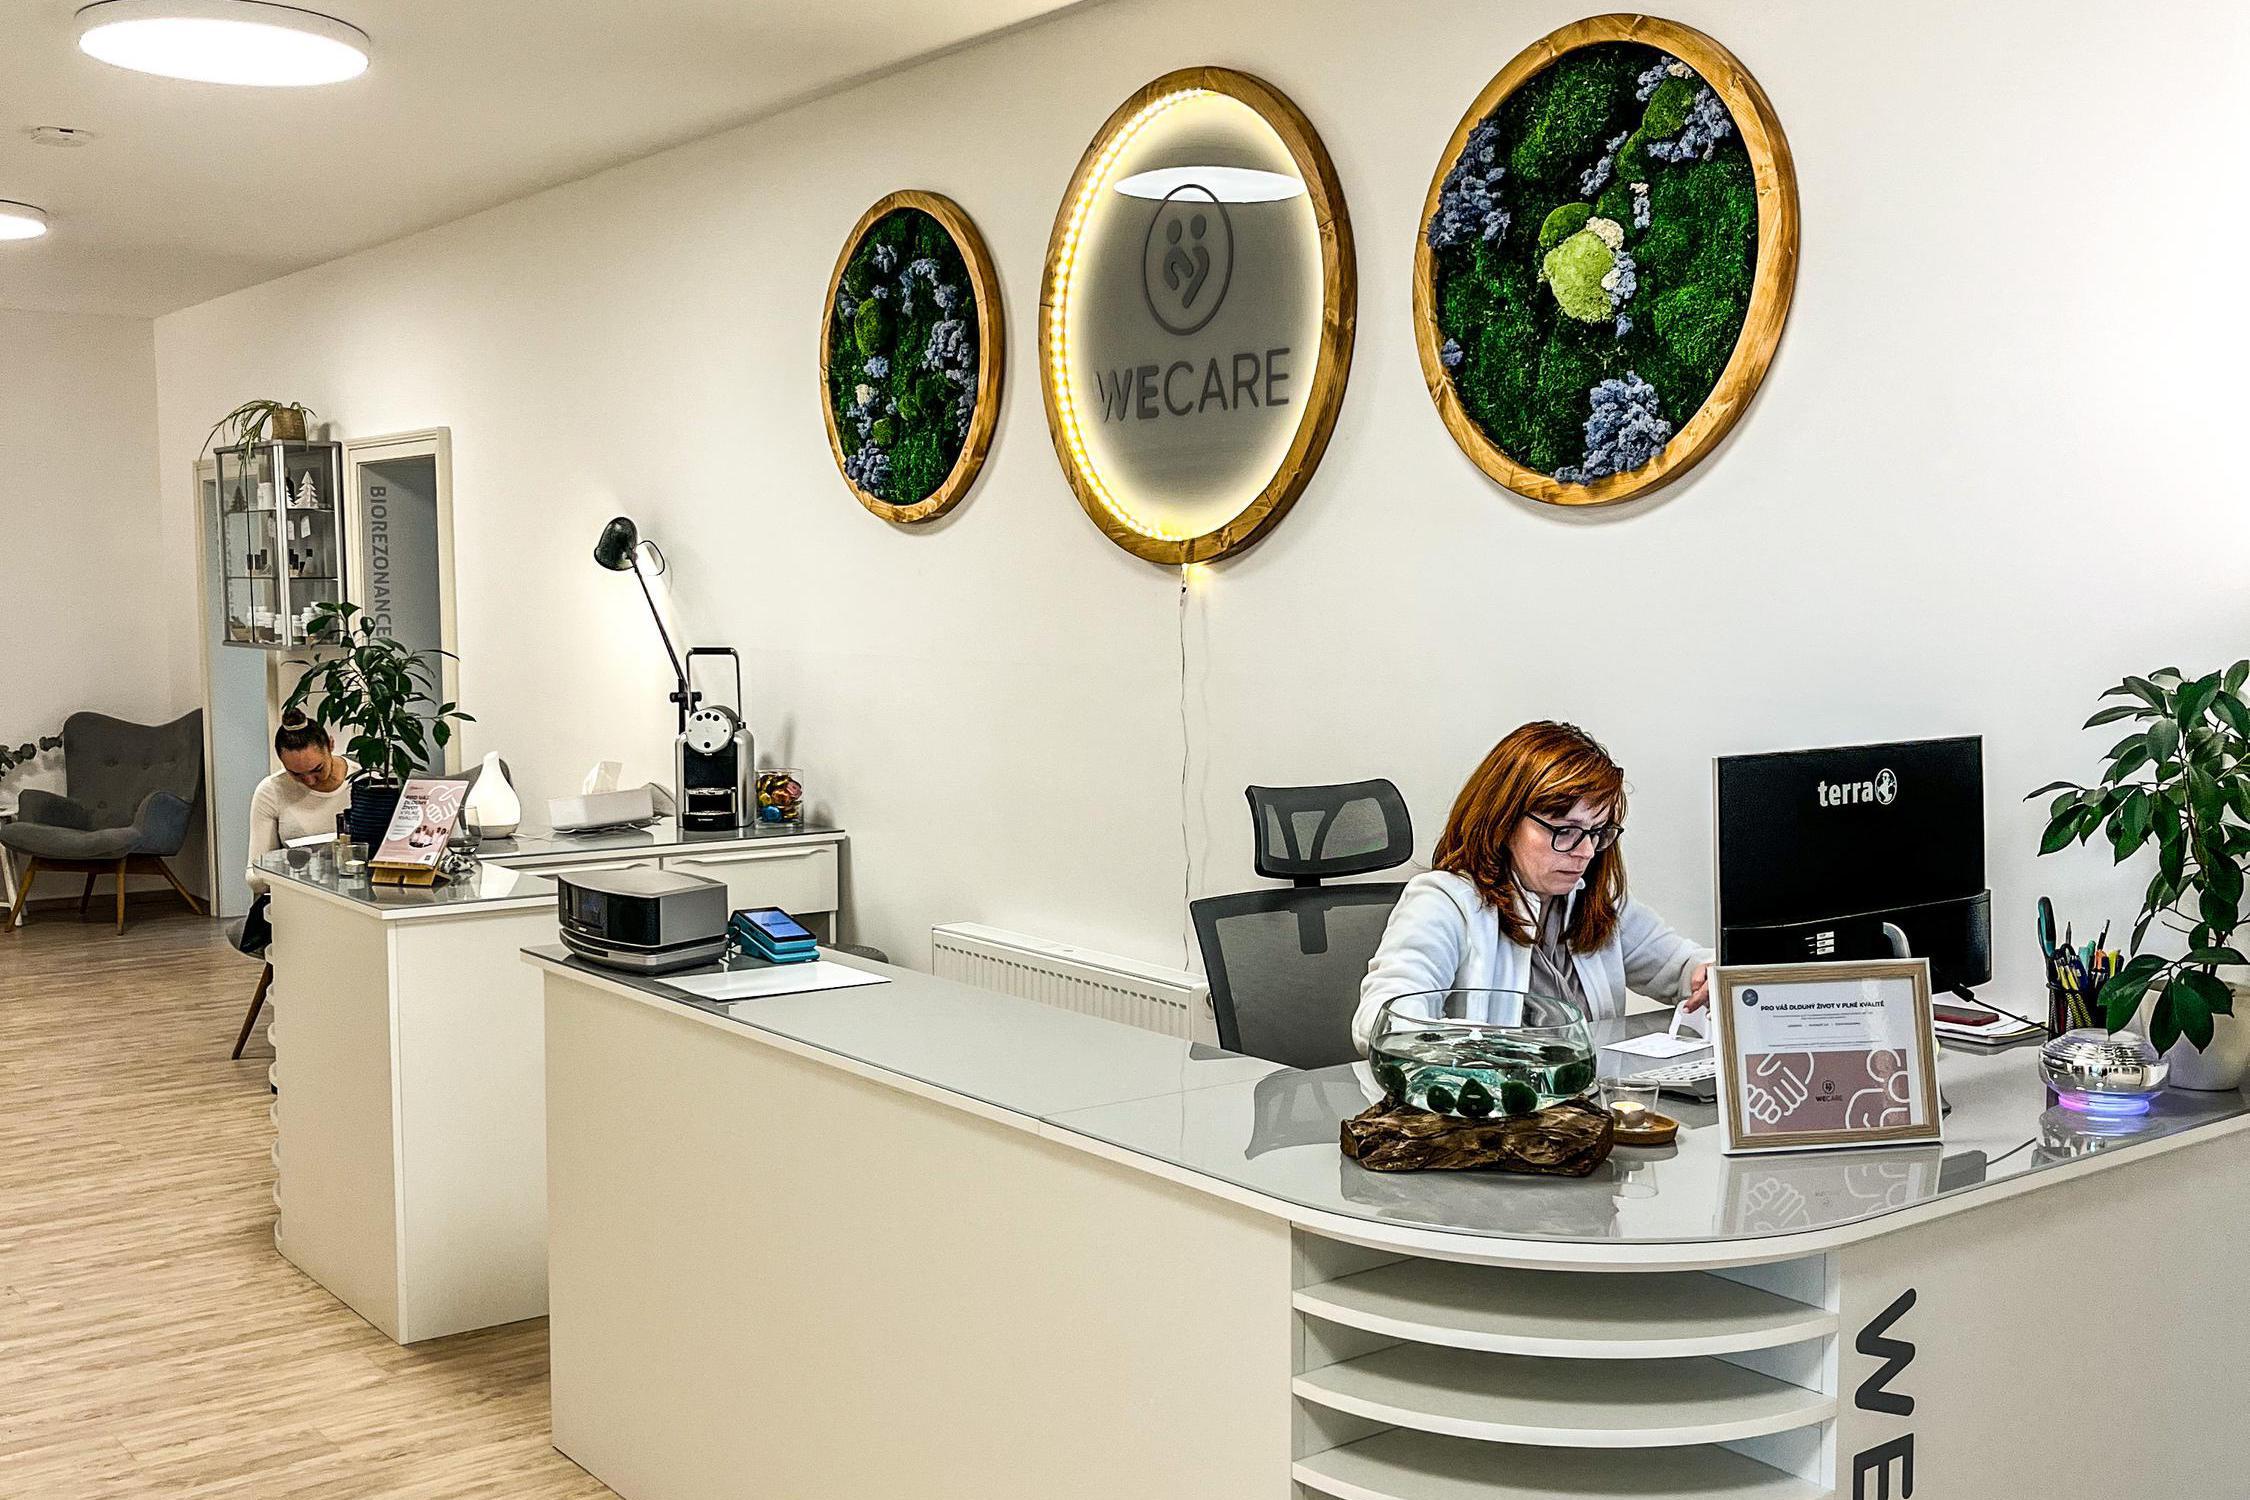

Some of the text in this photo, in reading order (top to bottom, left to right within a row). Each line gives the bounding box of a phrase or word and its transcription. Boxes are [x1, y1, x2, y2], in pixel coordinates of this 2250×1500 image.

[1096, 347, 1291, 422] WECARE
[369, 486, 393, 637] BIOREZONANCE
[1816, 780, 1874, 807] terra
[1853, 1287, 1917, 1500] WE
